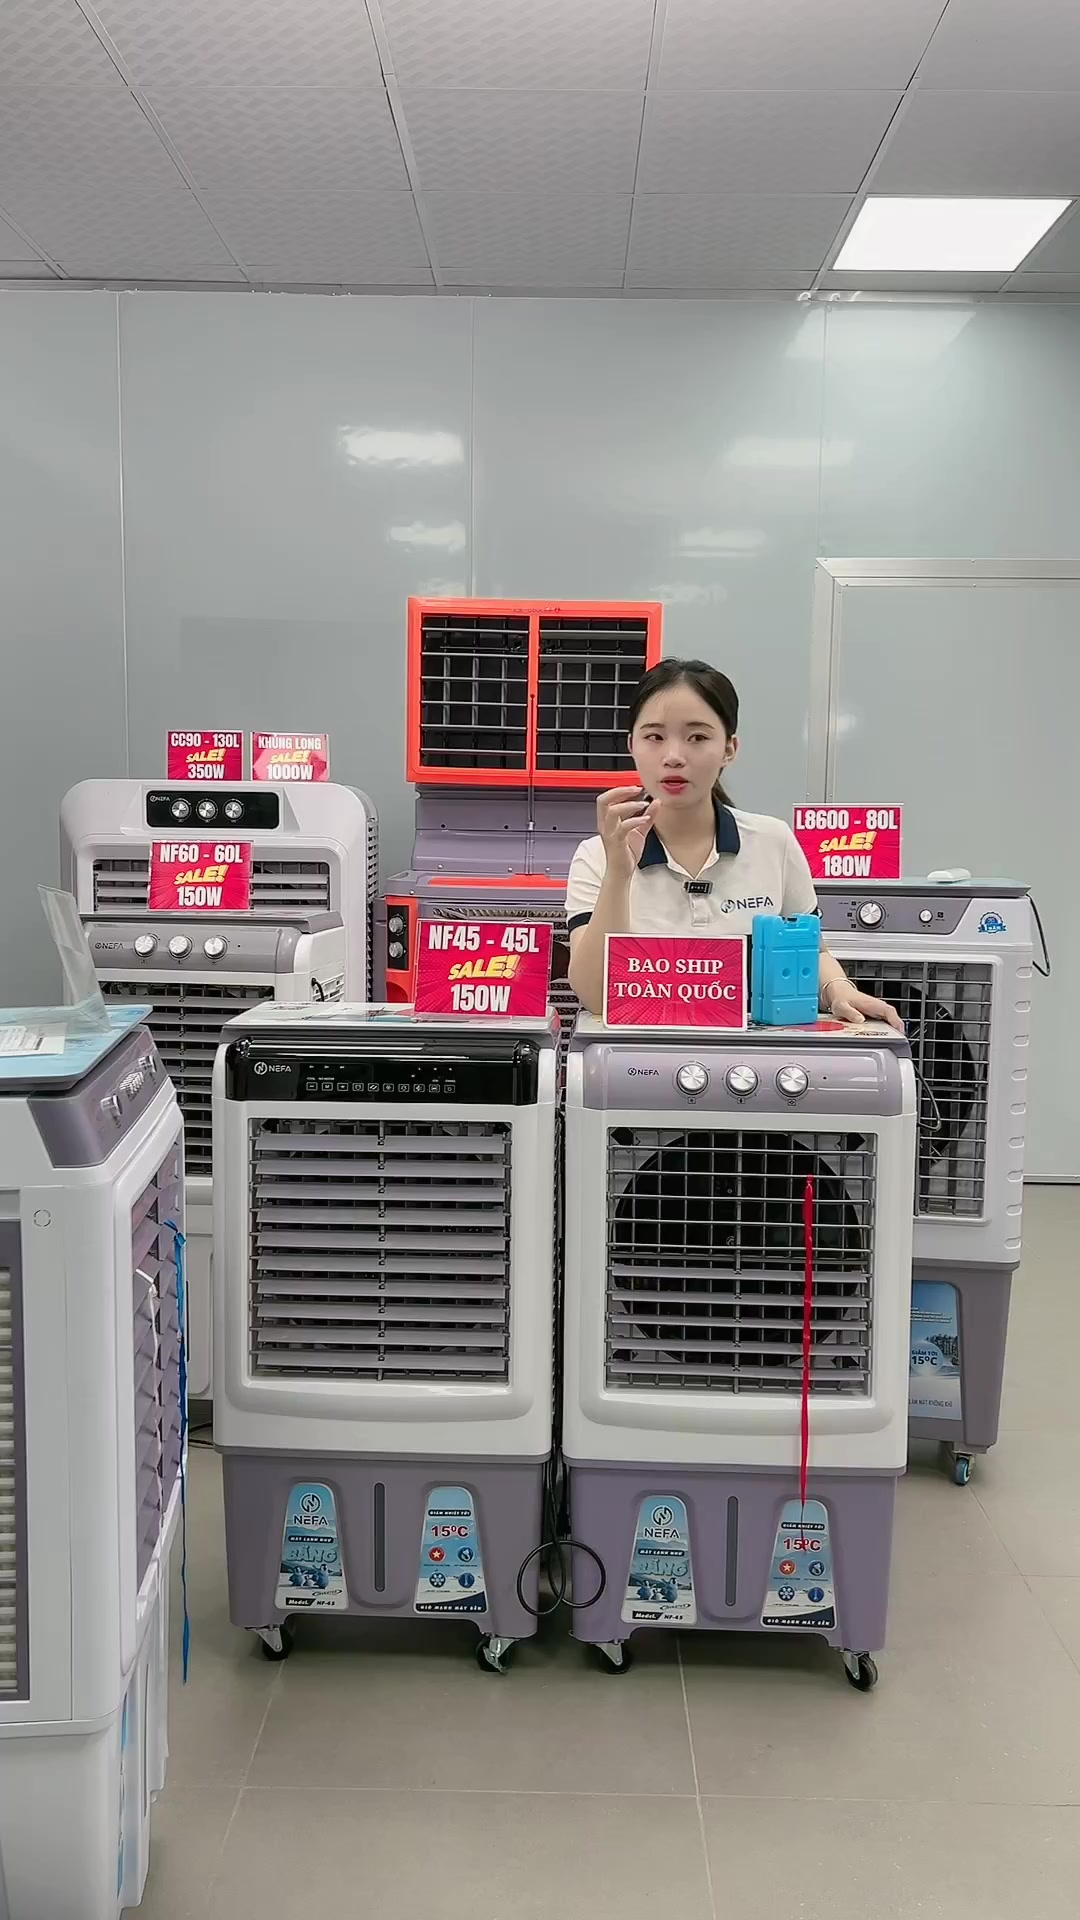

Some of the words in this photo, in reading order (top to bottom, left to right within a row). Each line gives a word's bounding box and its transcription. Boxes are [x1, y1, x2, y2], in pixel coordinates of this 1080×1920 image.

[171, 733, 202, 747] CC90
[212, 733, 240, 748] 130L
[295, 737, 321, 750] LONG
[185, 748, 227, 763] SALE!
[270, 750, 312, 764] SALE!
[187, 764, 225, 780] 350W
[266, 764, 314, 780] 1000W
[796, 809, 849, 830] L8600
[866, 809, 898, 830] 80L
[818, 831, 877, 853] SALE!
[159, 844, 199, 864] NF60
[214, 844, 243, 864] 60L
[174, 864, 229, 885] SALE!
[822, 855, 872, 877] 180W
[176, 886, 223, 907] 150W
[736, 896, 774, 910] NEFA
[428, 925, 480, 950] NF45
[500, 927, 540, 953] 45L
[448, 954, 521, 982] SALE!
[626, 957, 671, 974] BAO
[675, 958, 724, 975] SHIP
[450, 984, 511, 1012] 150W
[614, 974, 674, 999] TOÀN
[678, 977, 737, 1004] QUỐC
[268, 1064, 292, 1073] NEFA
[293, 1515, 329, 1526] NEFA
[644, 1528, 680, 1539] NEFA
